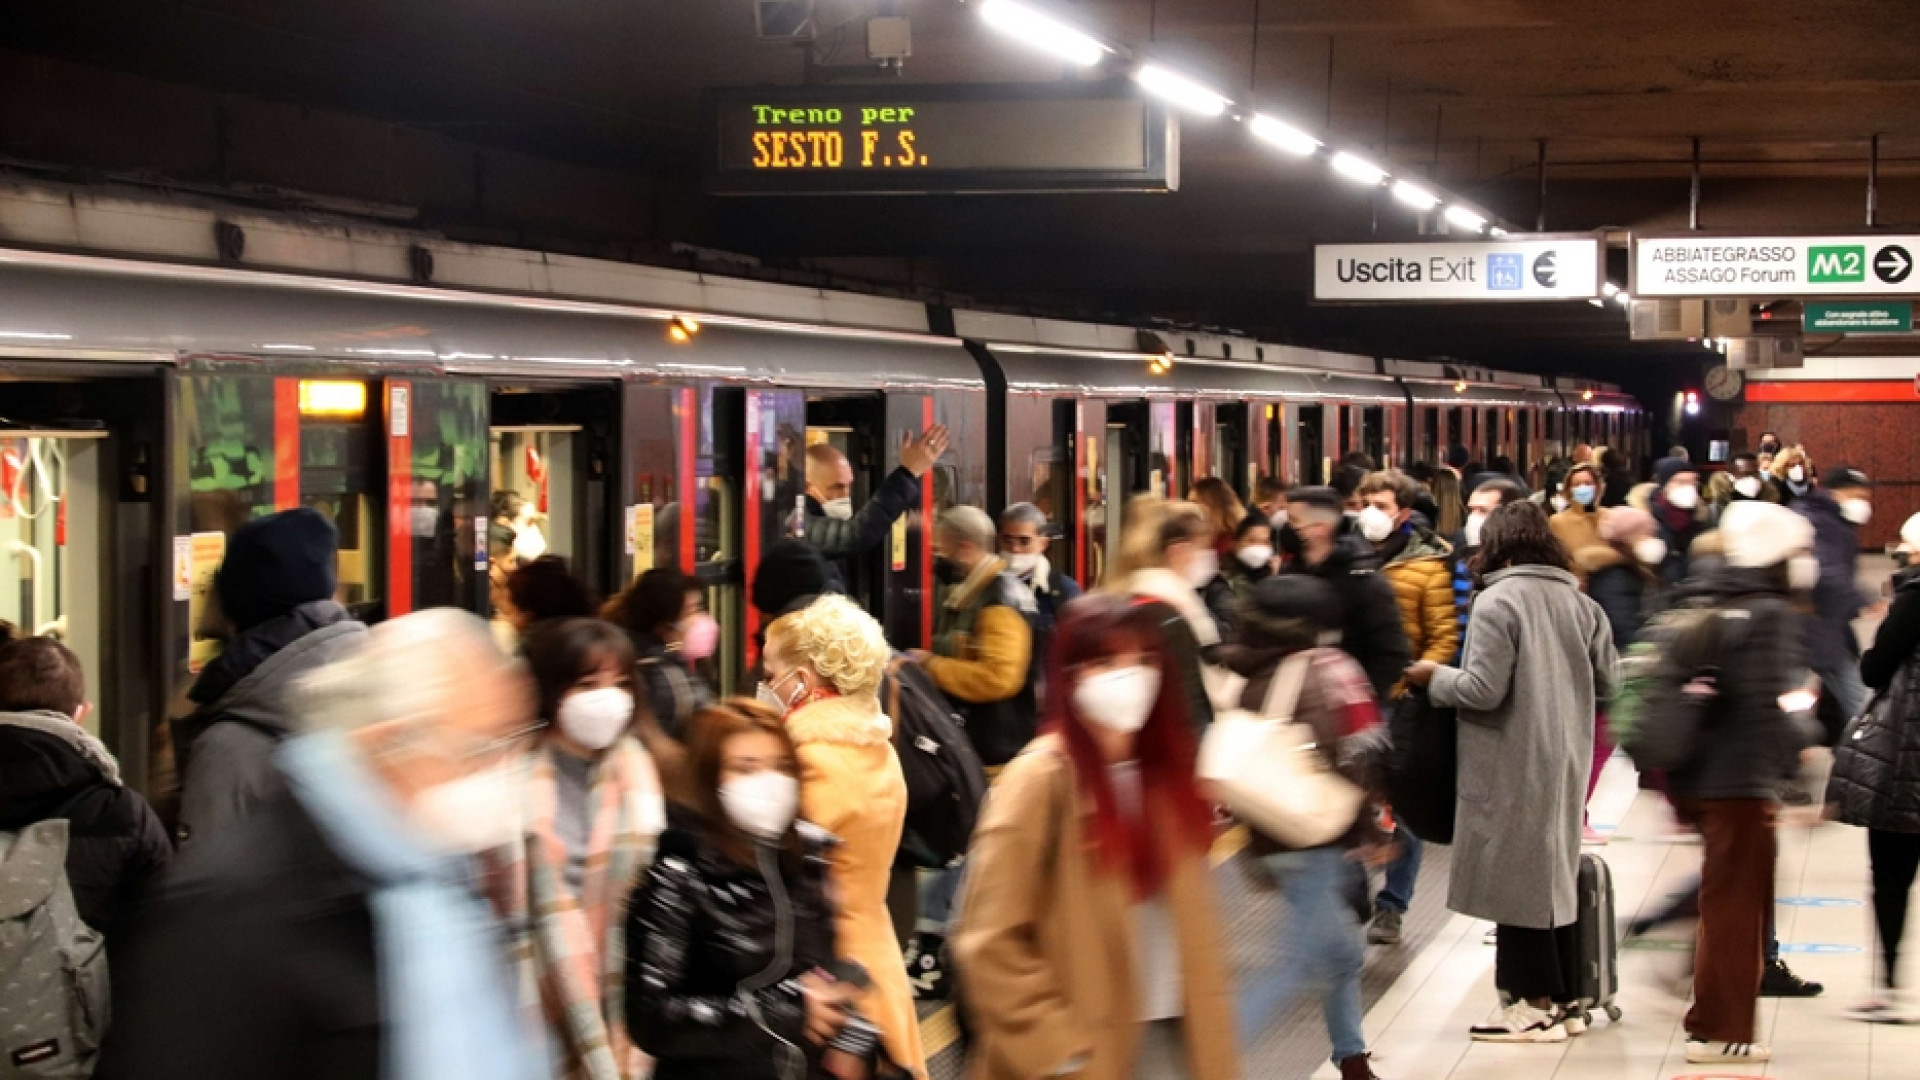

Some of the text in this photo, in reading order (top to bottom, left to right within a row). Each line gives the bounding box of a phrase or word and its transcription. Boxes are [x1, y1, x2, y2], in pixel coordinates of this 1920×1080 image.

[752, 105, 915, 124] Treno per
[752, 131, 929, 167] SESTO F.S.
[1653, 246, 1796, 262] ABBIATEGRASSO
[1811, 252, 1860, 276] M2
[1337, 257, 1476, 282] Uscita Exit
[1665, 267, 1796, 282] ASSAGO Forum
